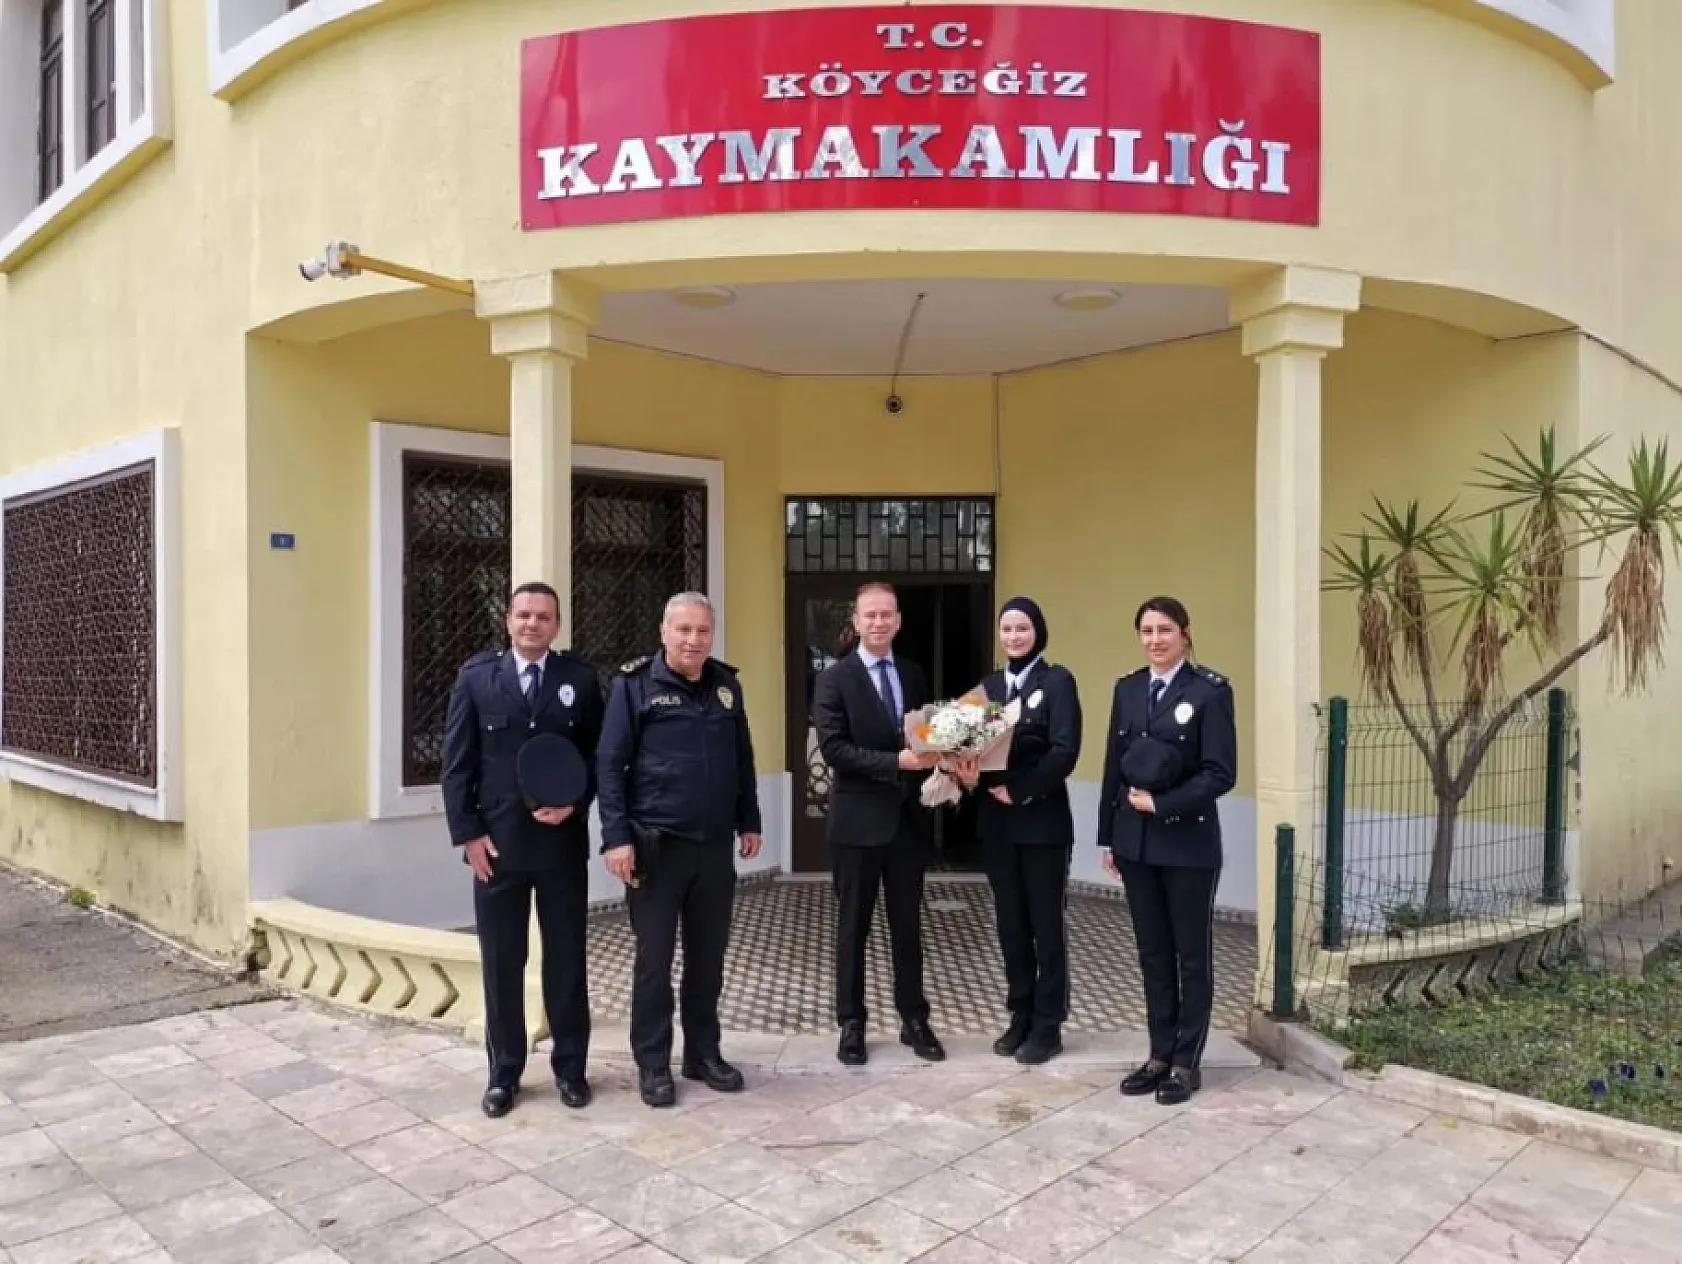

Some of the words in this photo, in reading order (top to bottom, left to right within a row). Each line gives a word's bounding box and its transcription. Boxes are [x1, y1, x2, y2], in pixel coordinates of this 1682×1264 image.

[876, 22, 983, 49] T.C.
[762, 62, 1087, 99] KÖYCEĞİZ
[537, 118, 1291, 200] KAYMAKAMLIĞI
